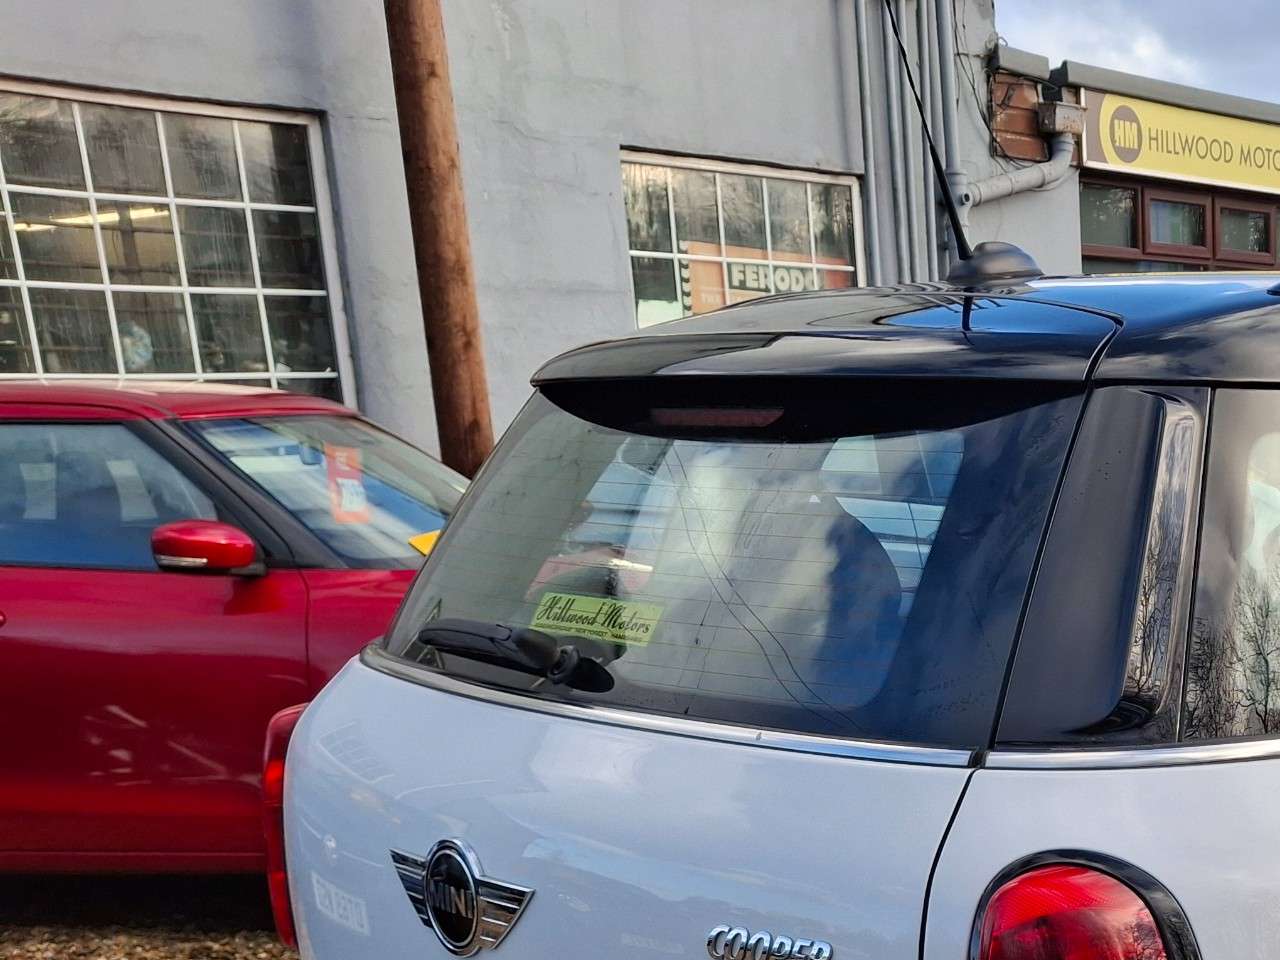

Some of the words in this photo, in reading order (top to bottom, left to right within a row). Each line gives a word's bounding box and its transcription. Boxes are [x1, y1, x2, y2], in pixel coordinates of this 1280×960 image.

[1113, 119, 1139, 149] HM
[1147, 127, 1234, 163] HILLWOOD
[730, 263, 819, 292] FERODO
[536, 595, 605, 626] Hillwood
[601, 601, 651, 634] Motors
[429, 880, 475, 919] MINI
